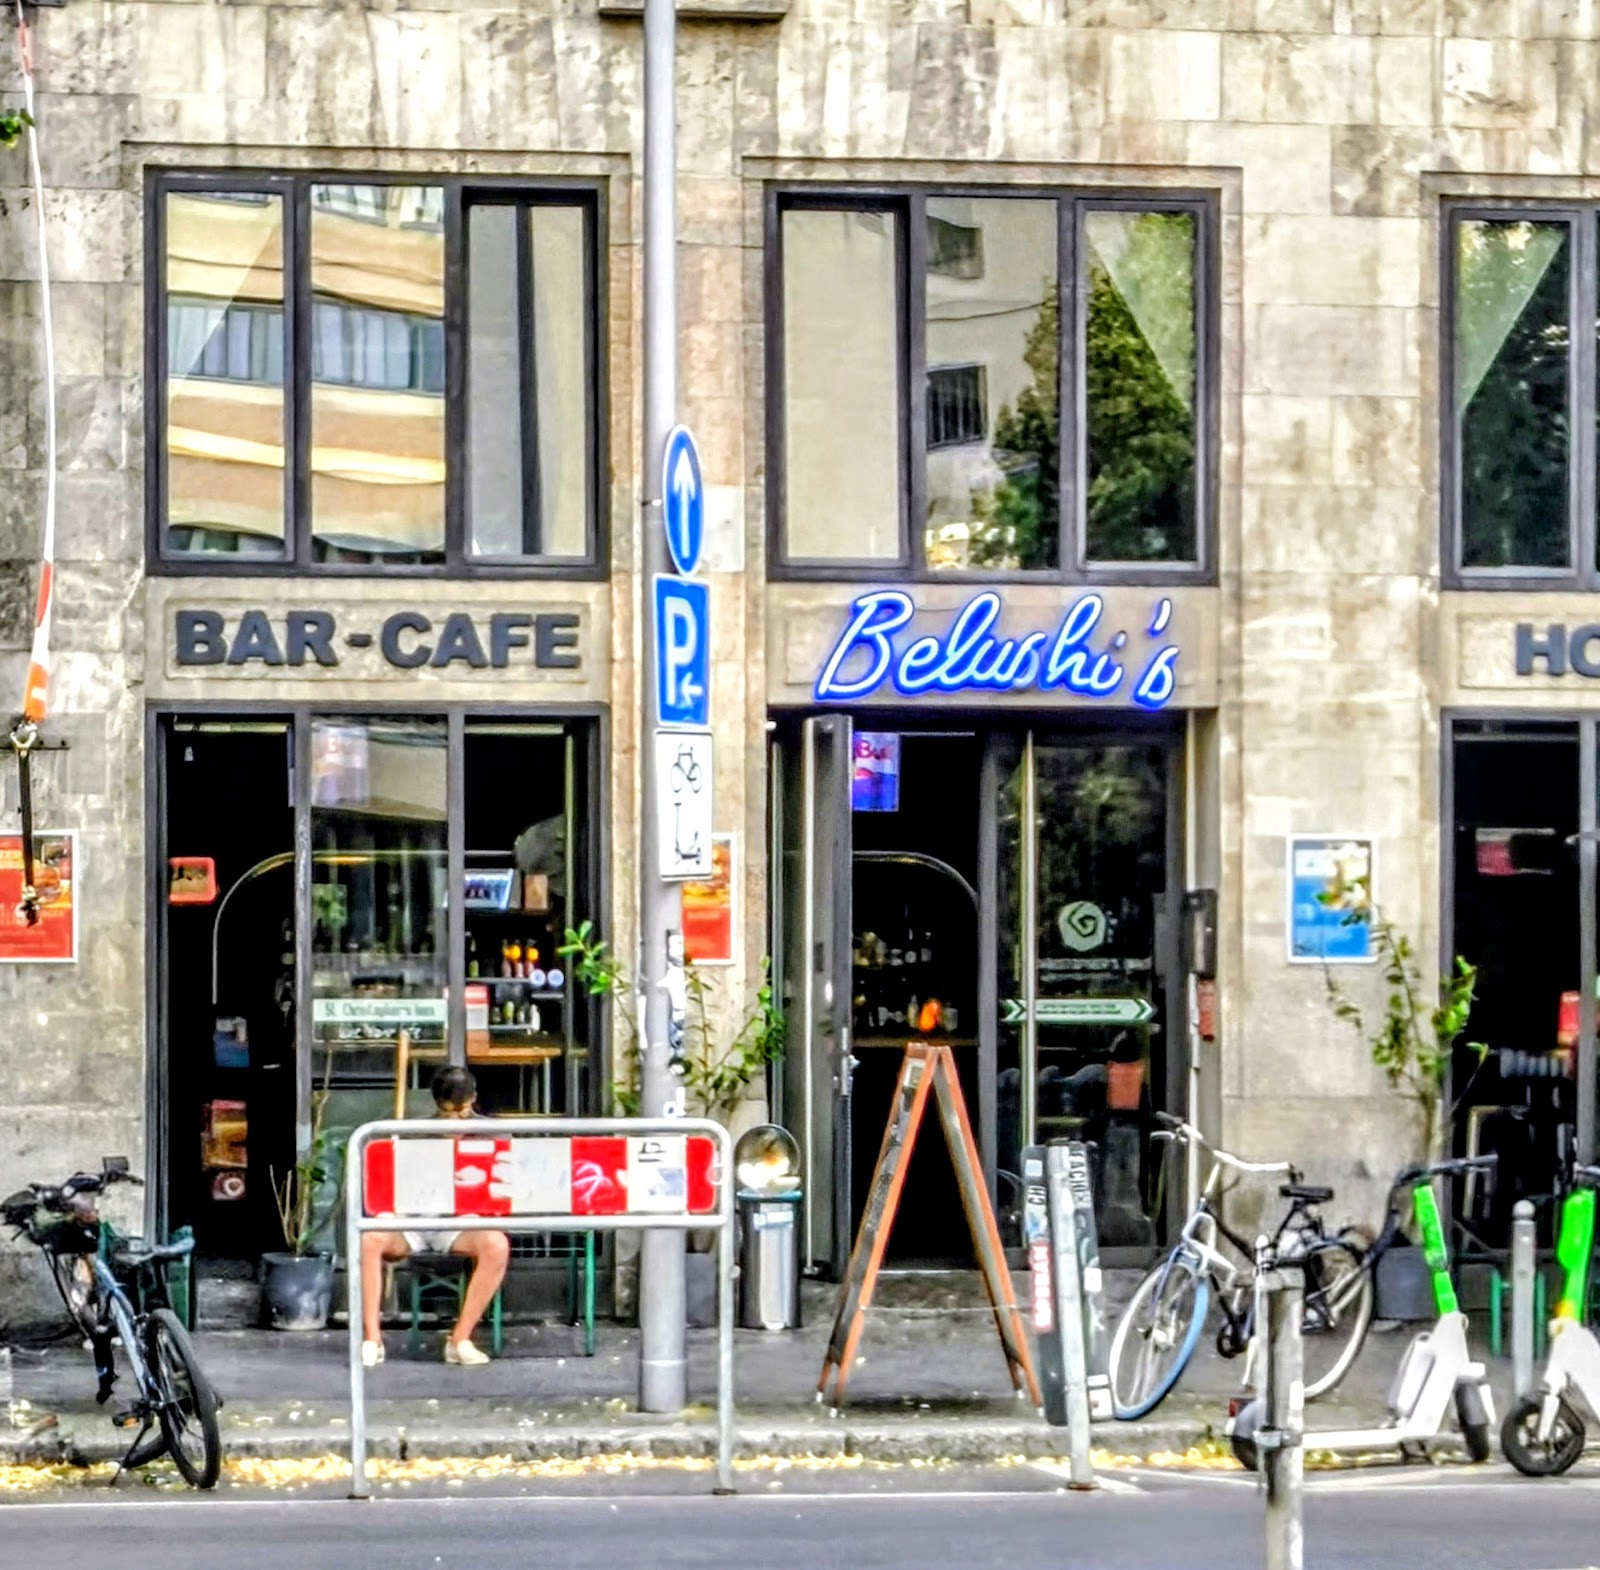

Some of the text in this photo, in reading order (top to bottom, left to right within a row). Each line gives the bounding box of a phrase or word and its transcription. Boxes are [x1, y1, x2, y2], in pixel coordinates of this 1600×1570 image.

[176, 610, 581, 669] BAR-CAFE
[664, 596, 697, 706] P
[815, 590, 1181, 710] Belushi's
